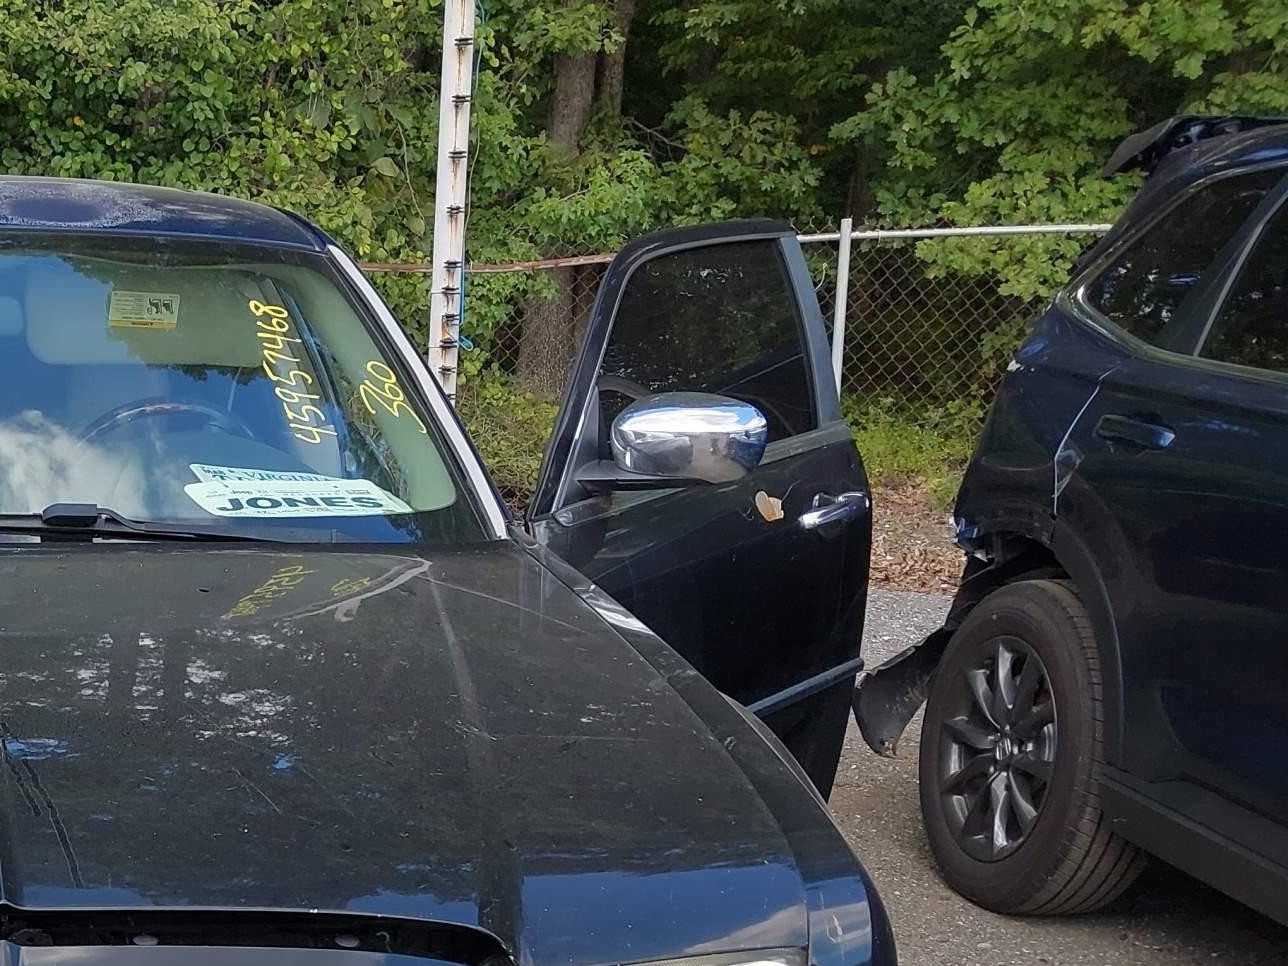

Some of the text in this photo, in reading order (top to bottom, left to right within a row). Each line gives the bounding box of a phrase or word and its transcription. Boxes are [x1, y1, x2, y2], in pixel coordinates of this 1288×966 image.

[249, 300, 338, 444] 45957468
[359, 360, 427, 434] 360
[243, 470, 329, 482] VIRGINI
[217, 497, 384, 512] JONES
